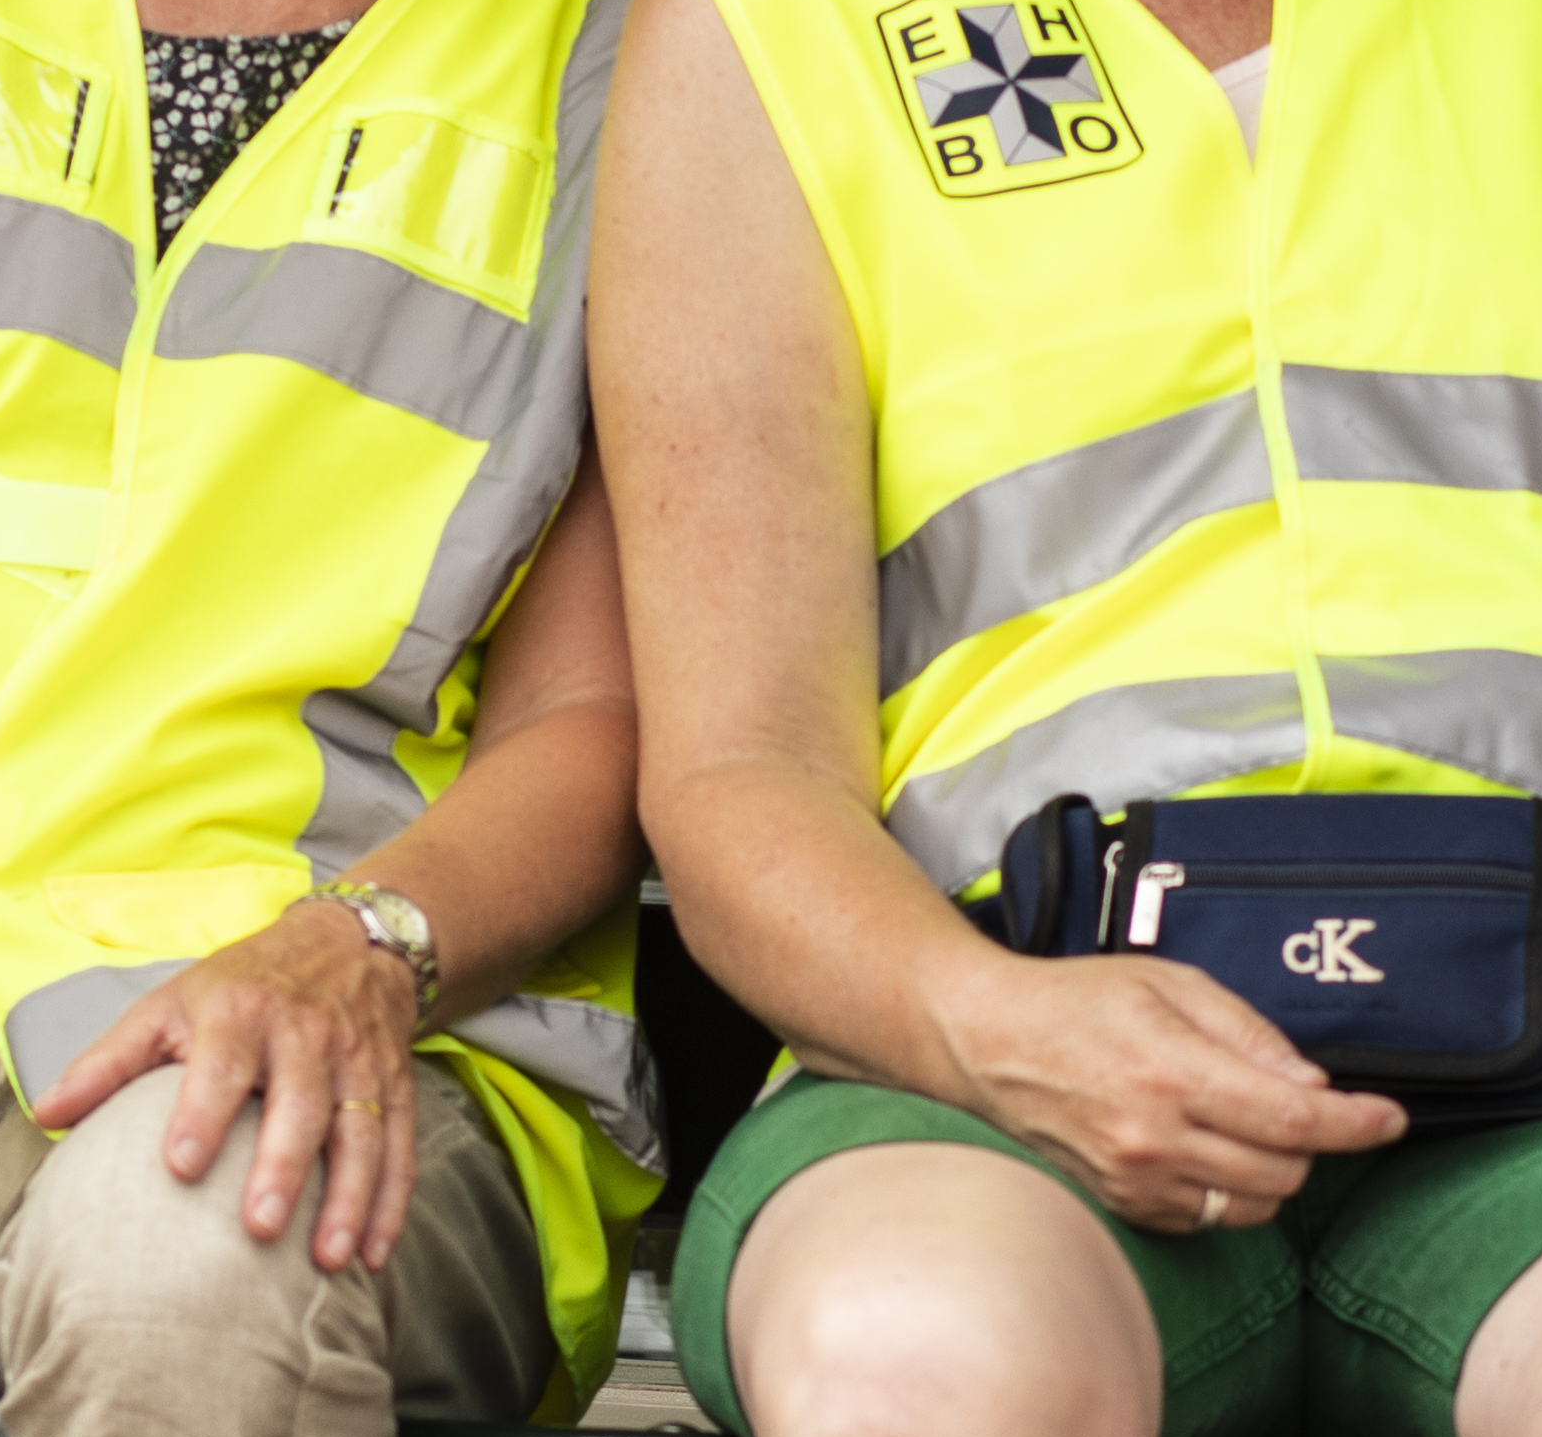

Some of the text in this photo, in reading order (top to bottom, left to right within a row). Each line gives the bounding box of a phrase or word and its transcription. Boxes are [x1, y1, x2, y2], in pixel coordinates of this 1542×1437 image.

[899, 3, 1079, 64] E H
[935, 115, 1118, 177] B O
